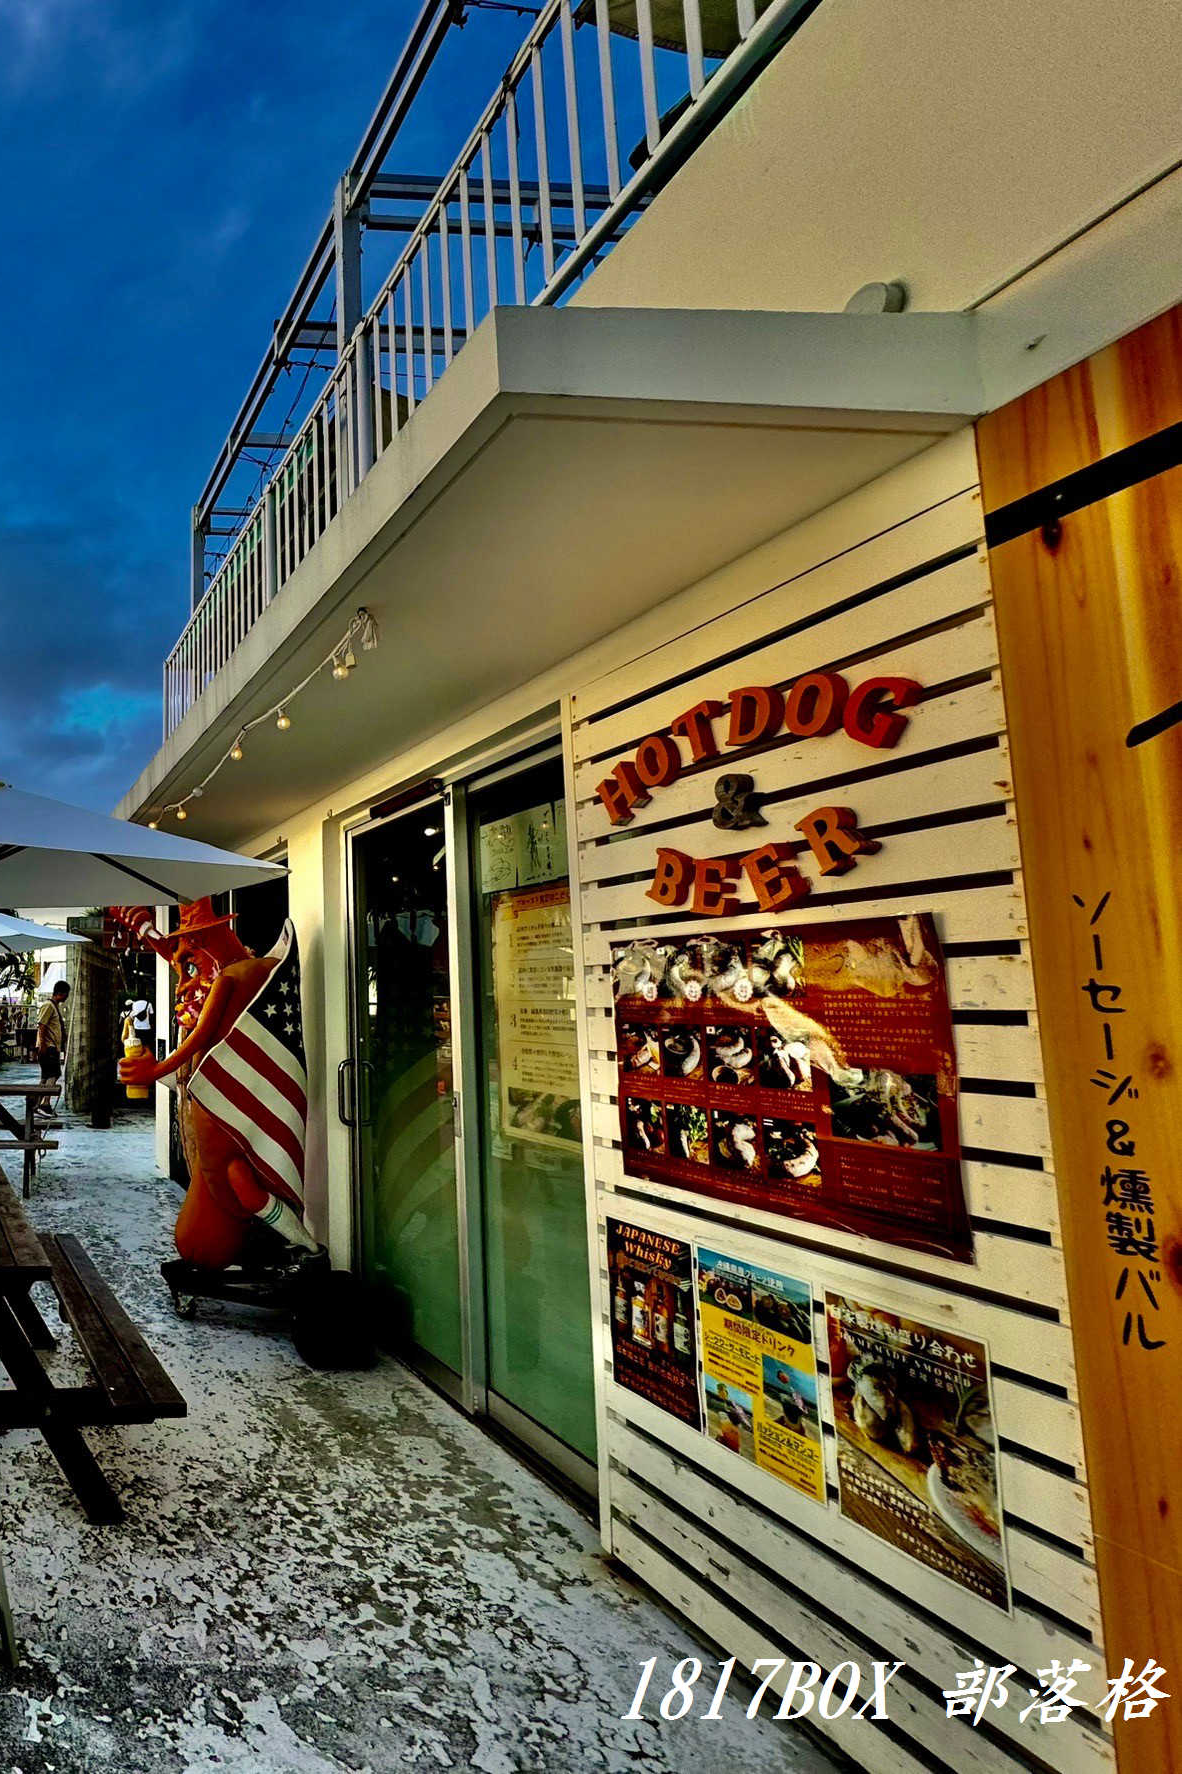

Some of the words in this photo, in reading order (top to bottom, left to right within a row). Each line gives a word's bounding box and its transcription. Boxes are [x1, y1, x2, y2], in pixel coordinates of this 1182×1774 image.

[595, 672, 924, 826] HOTDOG
[712, 773, 770, 831] &
[644, 806, 883, 916] BEER
[616, 1224, 681, 1255] JAPANESE
[625, 1240, 672, 1270] Whisky
